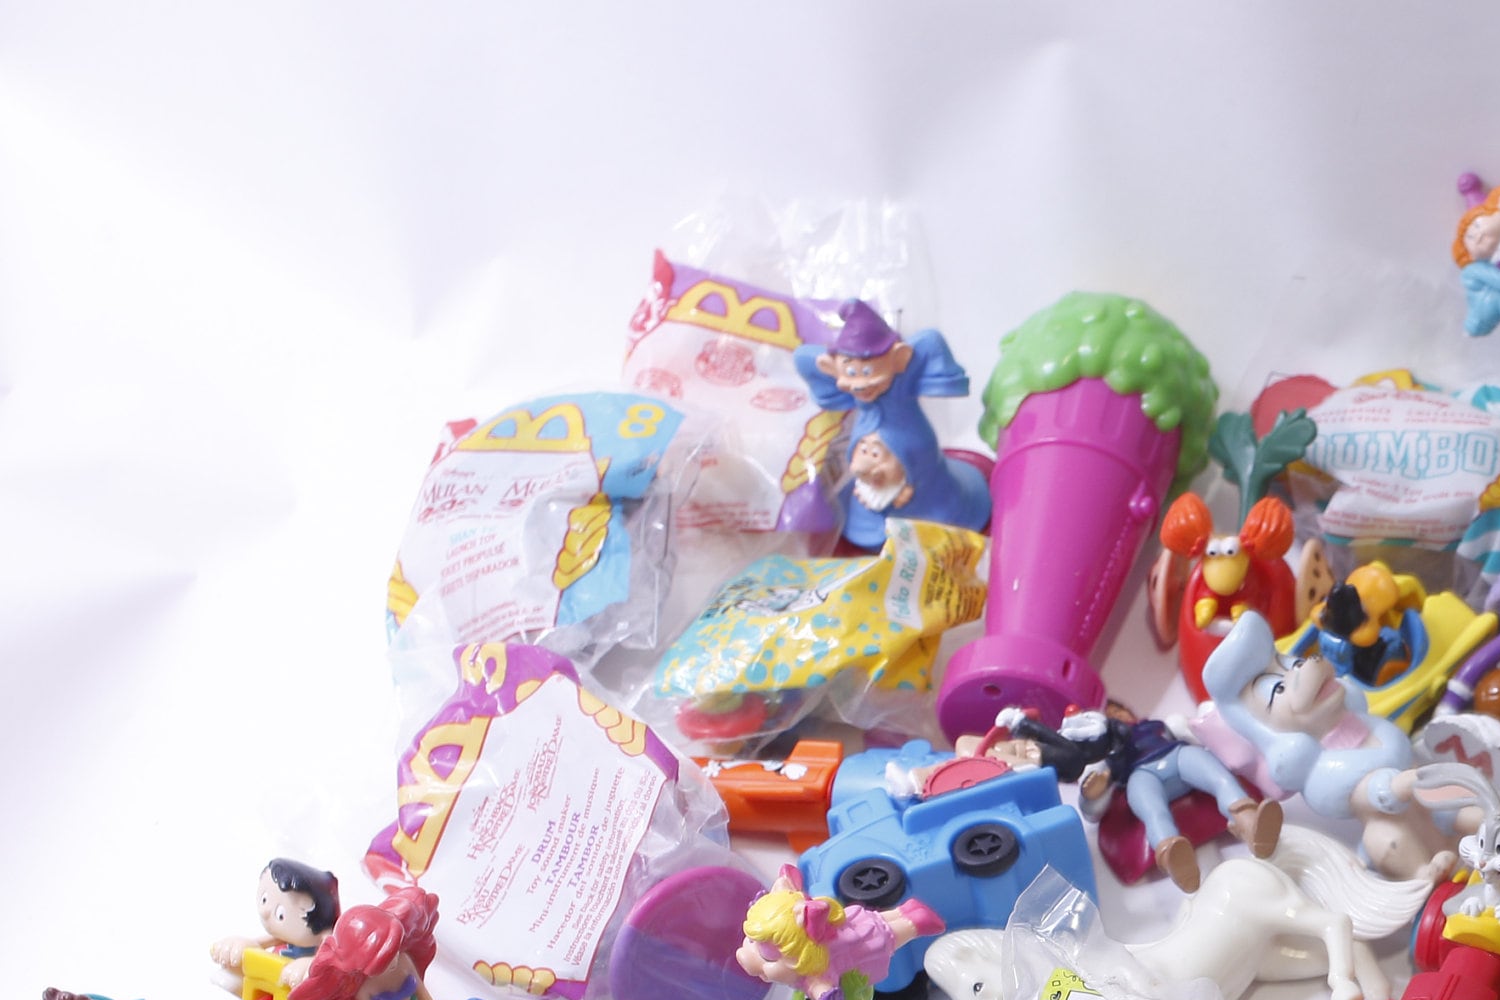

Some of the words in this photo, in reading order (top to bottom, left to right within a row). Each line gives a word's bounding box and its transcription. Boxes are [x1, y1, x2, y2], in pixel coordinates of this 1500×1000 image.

[618, 403, 666, 440] 8
[531, 820, 556, 864] DRUM
[545, 811, 581, 886] TAMBOUR
[567, 824, 600, 888] TAMBOR
